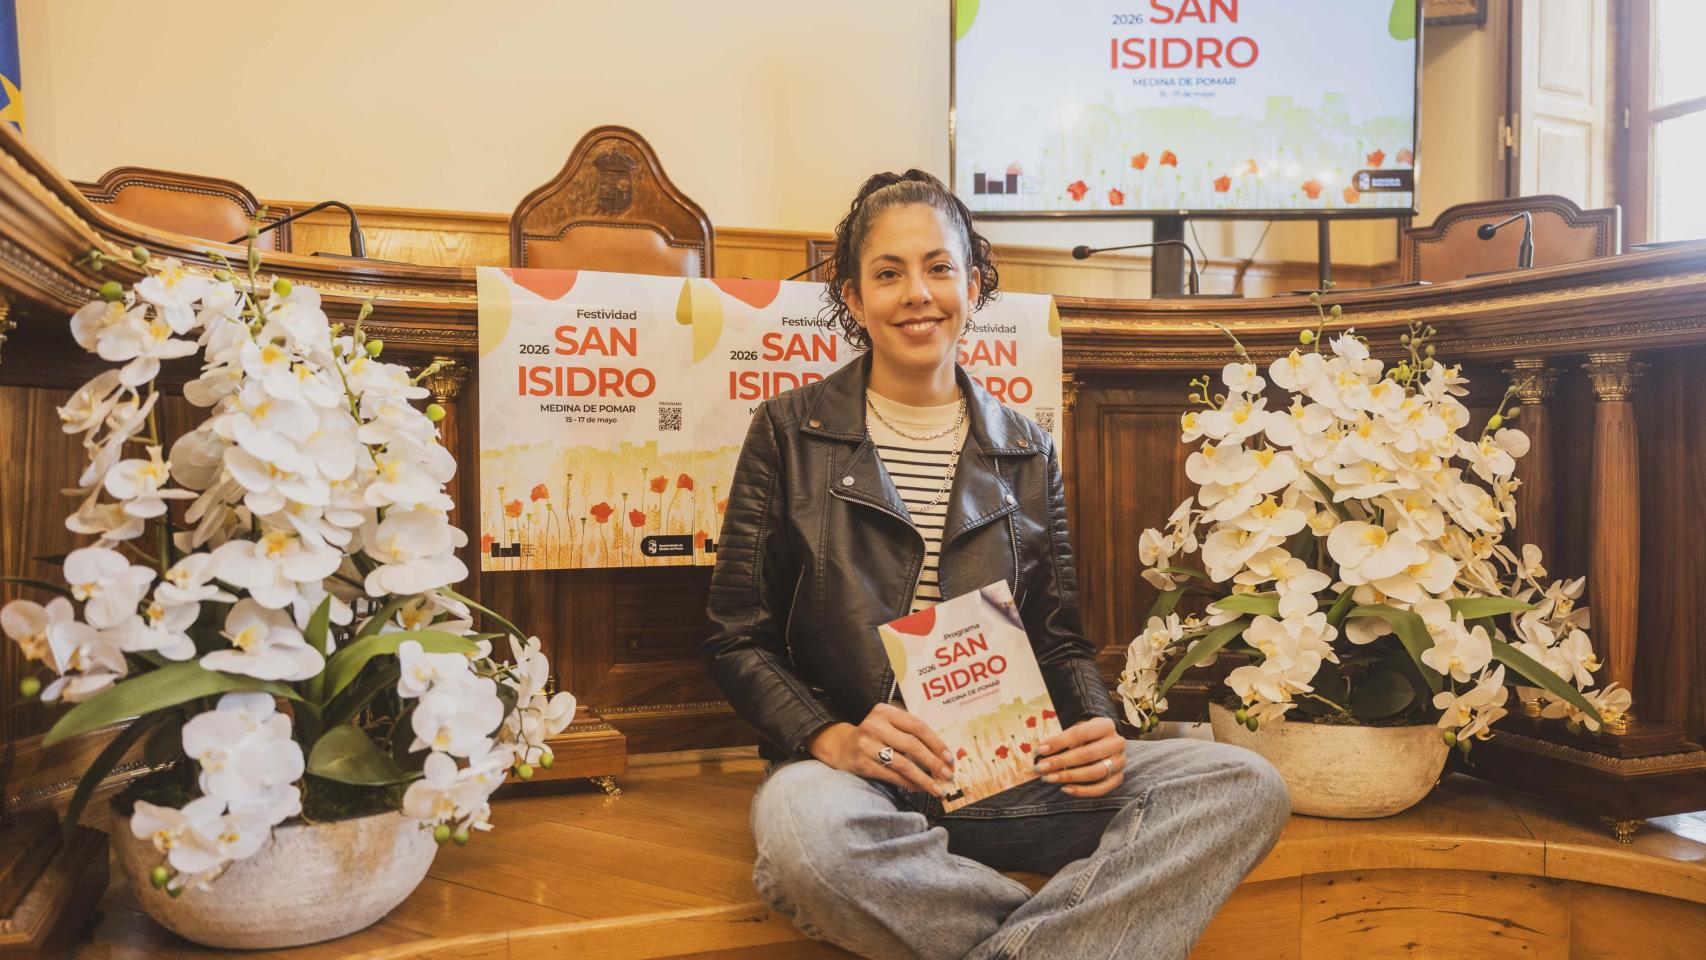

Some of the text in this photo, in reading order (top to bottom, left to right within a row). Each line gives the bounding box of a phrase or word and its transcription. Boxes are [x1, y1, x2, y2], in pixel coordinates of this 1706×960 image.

[1112, 14, 1144, 25] 2026
[1149, 0, 1239, 24] SAN
[1110, 36, 1259, 70] ISIDRO
[1132, 77, 1236, 87] MEDINA DE POMAR
[577, 309, 637, 320] Festividad
[782, 317, 836, 327] Festividad
[519, 325, 637, 356] 2026 SAN
[968, 324, 1016, 334] Festividad
[730, 332, 837, 362] 2026 SAN
[957, 339, 1017, 367] SAN
[518, 366, 656, 398] ISIDRO
[540, 404, 636, 413] MEDINA DE POMAR
[597, 417, 617, 425] mayo
[944, 623, 980, 641] Programa
[917, 633, 988, 676] 2026 SAN
[921, 655, 1007, 700] ISIDRO
[942, 693, 967, 705] MEDINA
[977, 680, 1000, 692] POMAR
